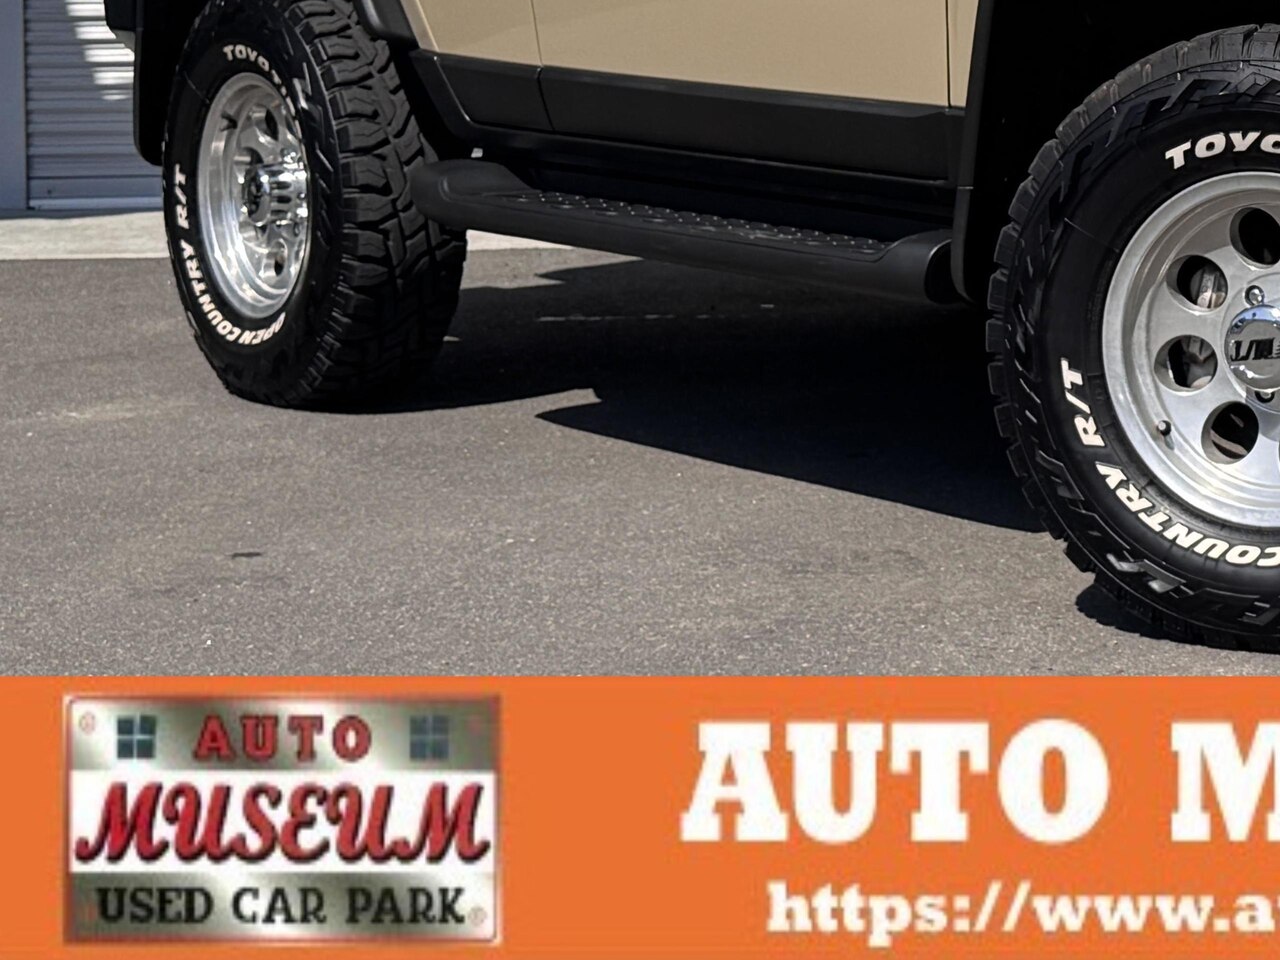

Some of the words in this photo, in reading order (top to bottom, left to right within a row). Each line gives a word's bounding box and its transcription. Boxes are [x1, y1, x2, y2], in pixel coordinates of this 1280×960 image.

[223, 44, 270, 72] TOYO
[174, 163, 189, 230] R/T
[180, 239, 242, 342] COUNTRY
[1060, 357, 1106, 447] R/T
